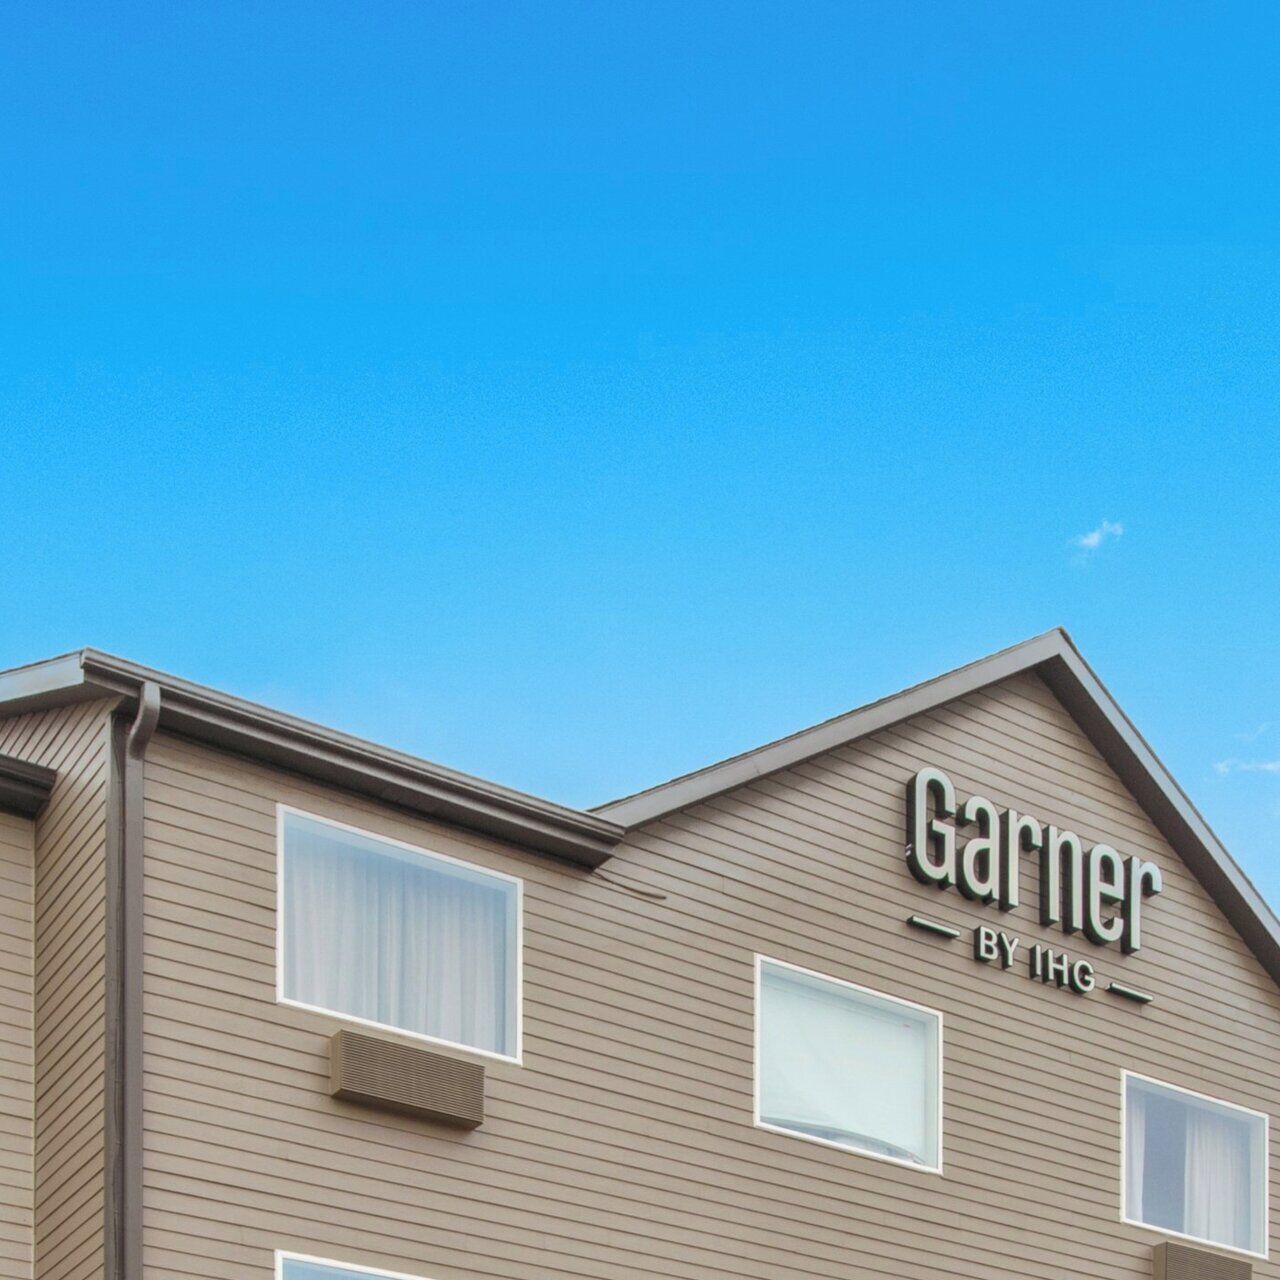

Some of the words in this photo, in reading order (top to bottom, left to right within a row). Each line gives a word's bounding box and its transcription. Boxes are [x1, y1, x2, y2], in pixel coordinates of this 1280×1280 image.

[906, 767, 1162, 955] Garner
[974, 926, 1019, 969] BY
[1029, 944, 1095, 994] IHG
